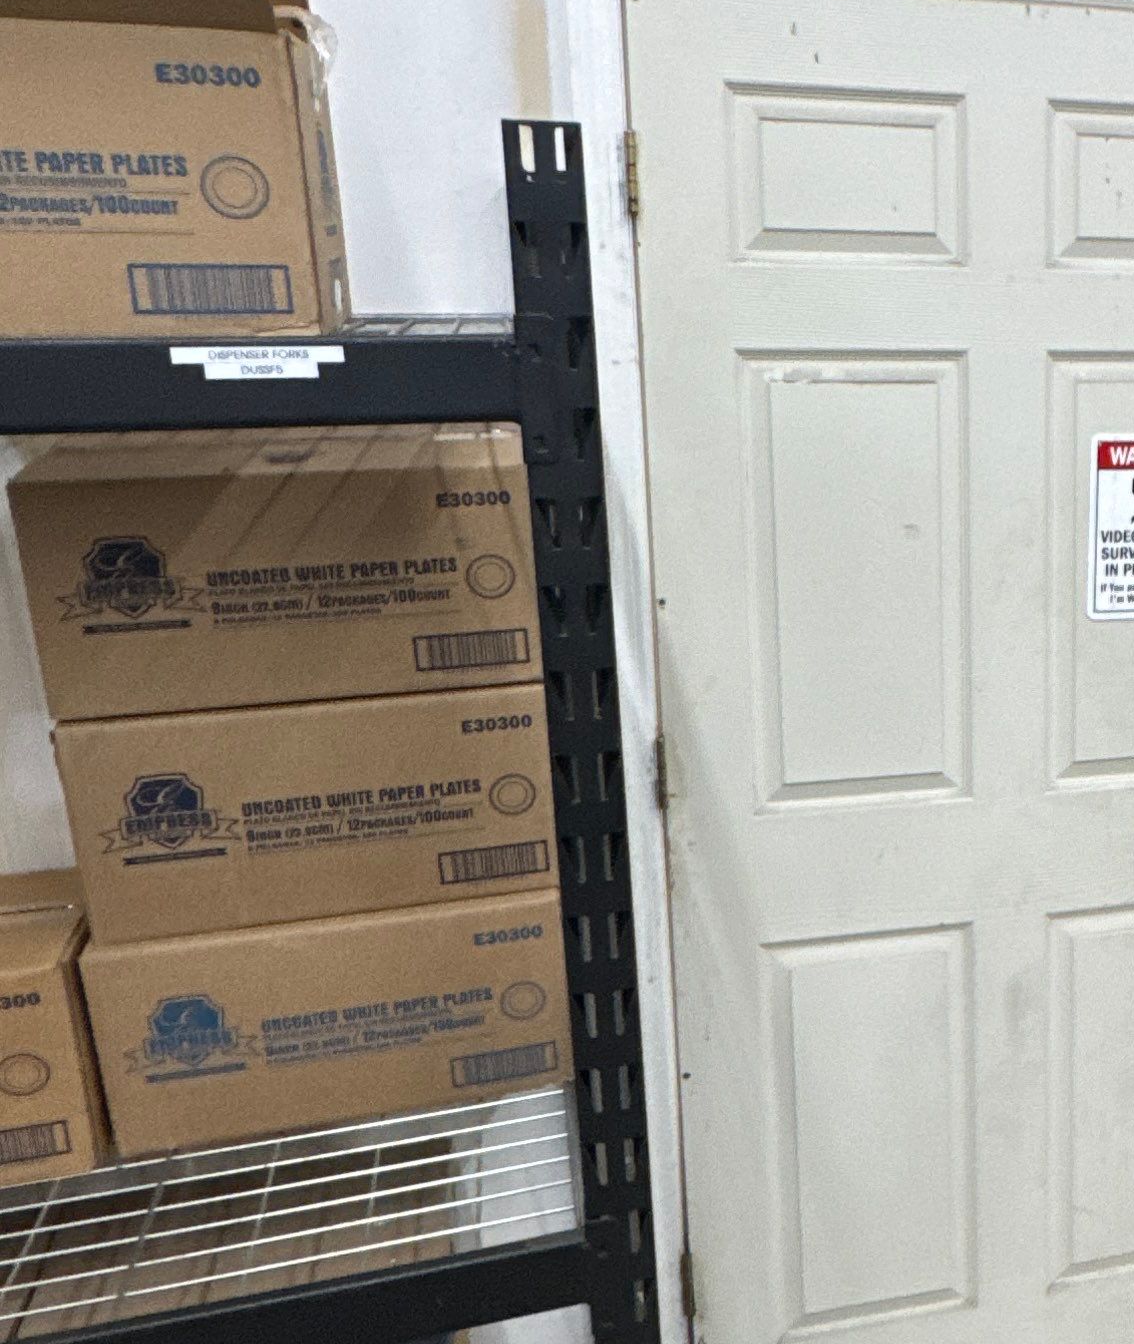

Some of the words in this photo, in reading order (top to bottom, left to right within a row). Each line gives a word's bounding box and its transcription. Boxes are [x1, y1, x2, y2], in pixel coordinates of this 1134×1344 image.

[155, 63, 261, 88] E30300
[34, 151, 104, 174] PAPER
[110, 153, 188, 177] PLATES
[208, 349, 268, 360] DISPENSER
[435, 490, 511, 508] E30300
[207, 567, 291, 587] UNCOATED
[295, 563, 344, 581] WHITE
[350, 560, 398, 578] PAPER
[404, 557, 457, 574] PLATES
[1105, 564, 1118, 576] IN
[1110, 582, 1124, 592] You
[461, 714, 532, 735] E30300
[242, 795, 321, 816] UNCOATED
[326, 790, 373, 809] WHITE
[379, 785, 425, 803] PAPER
[430, 779, 481, 798] PLATES
[474, 924, 543, 946] E30300
[393, 996, 438, 1016] PAPER
